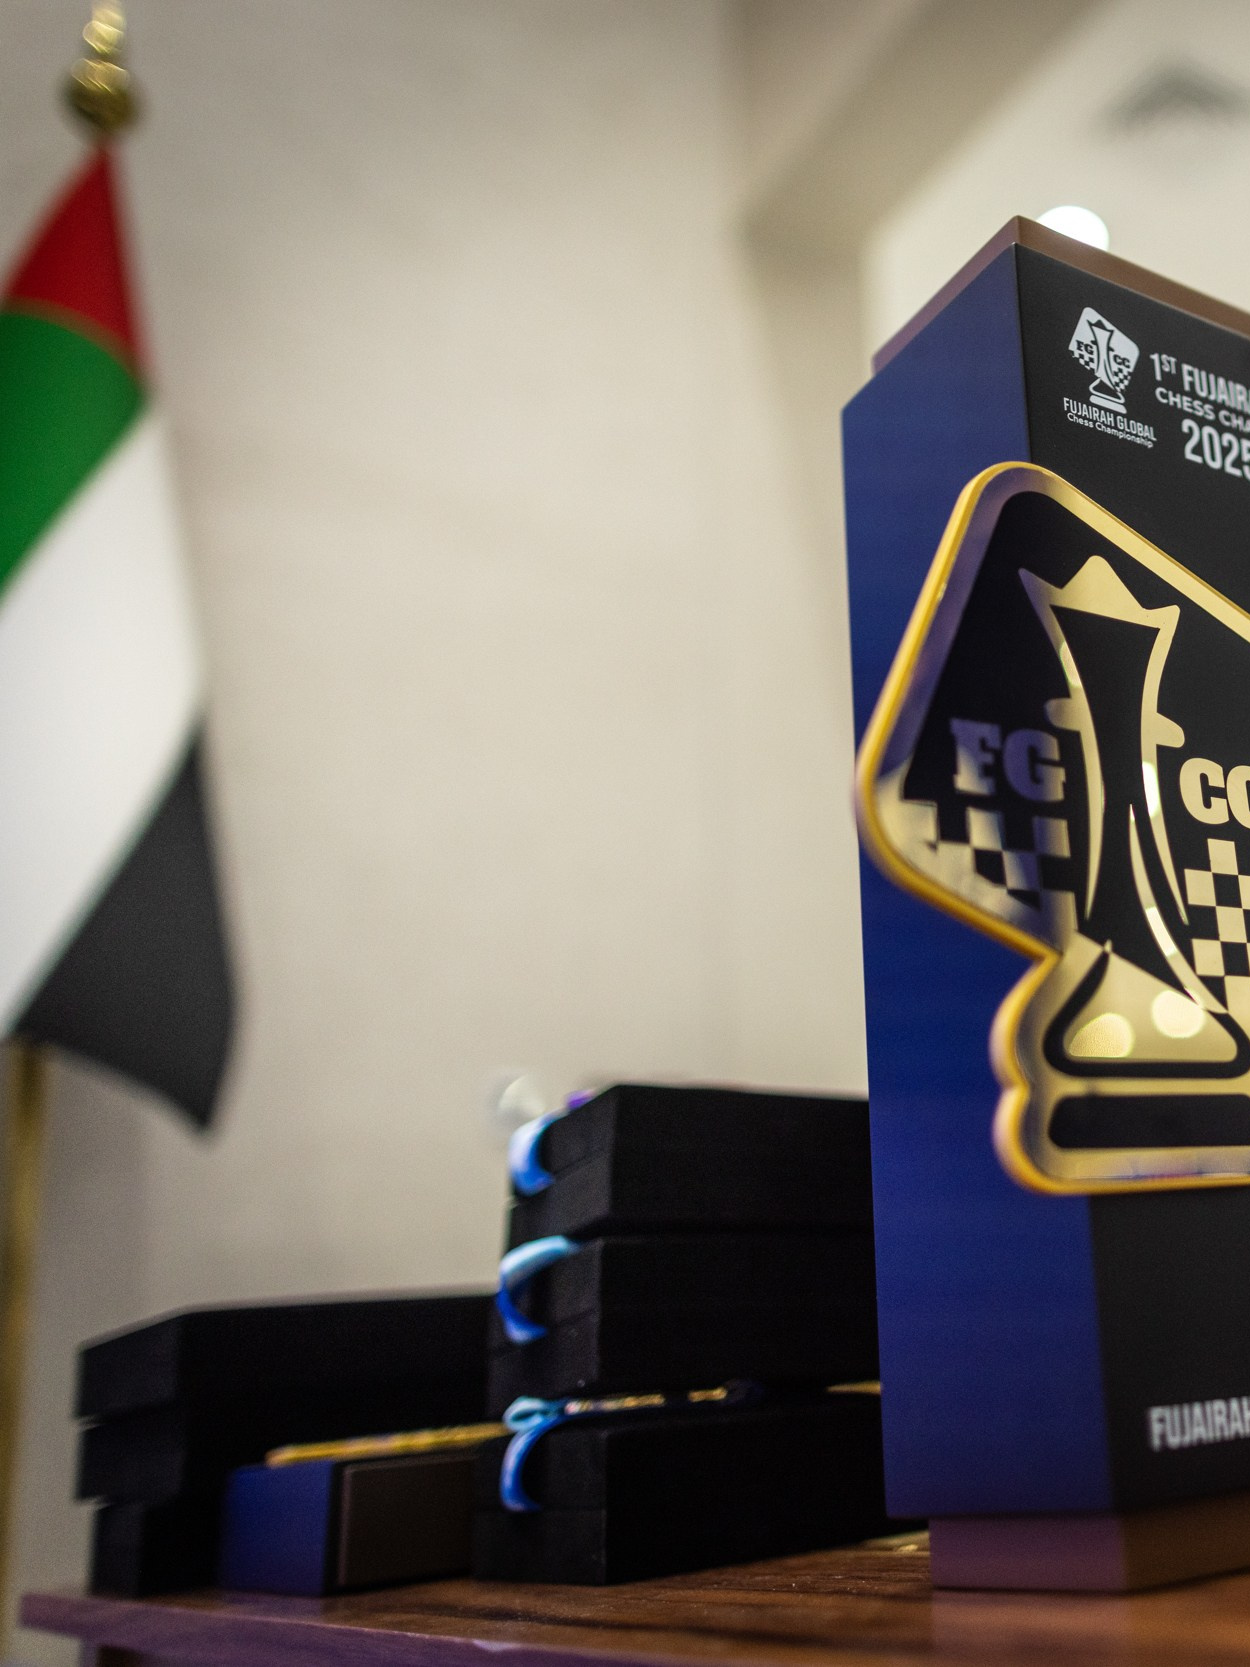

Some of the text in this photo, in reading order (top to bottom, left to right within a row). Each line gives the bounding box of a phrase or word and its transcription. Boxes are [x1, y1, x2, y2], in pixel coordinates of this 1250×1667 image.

[1063, 396, 1157, 442] FUJAIRAH GLOBAL
[1154, 386, 1216, 421] CHESS
[1066, 412, 1154, 449] Chess Championship
[950, 717, 1066, 802] FG
